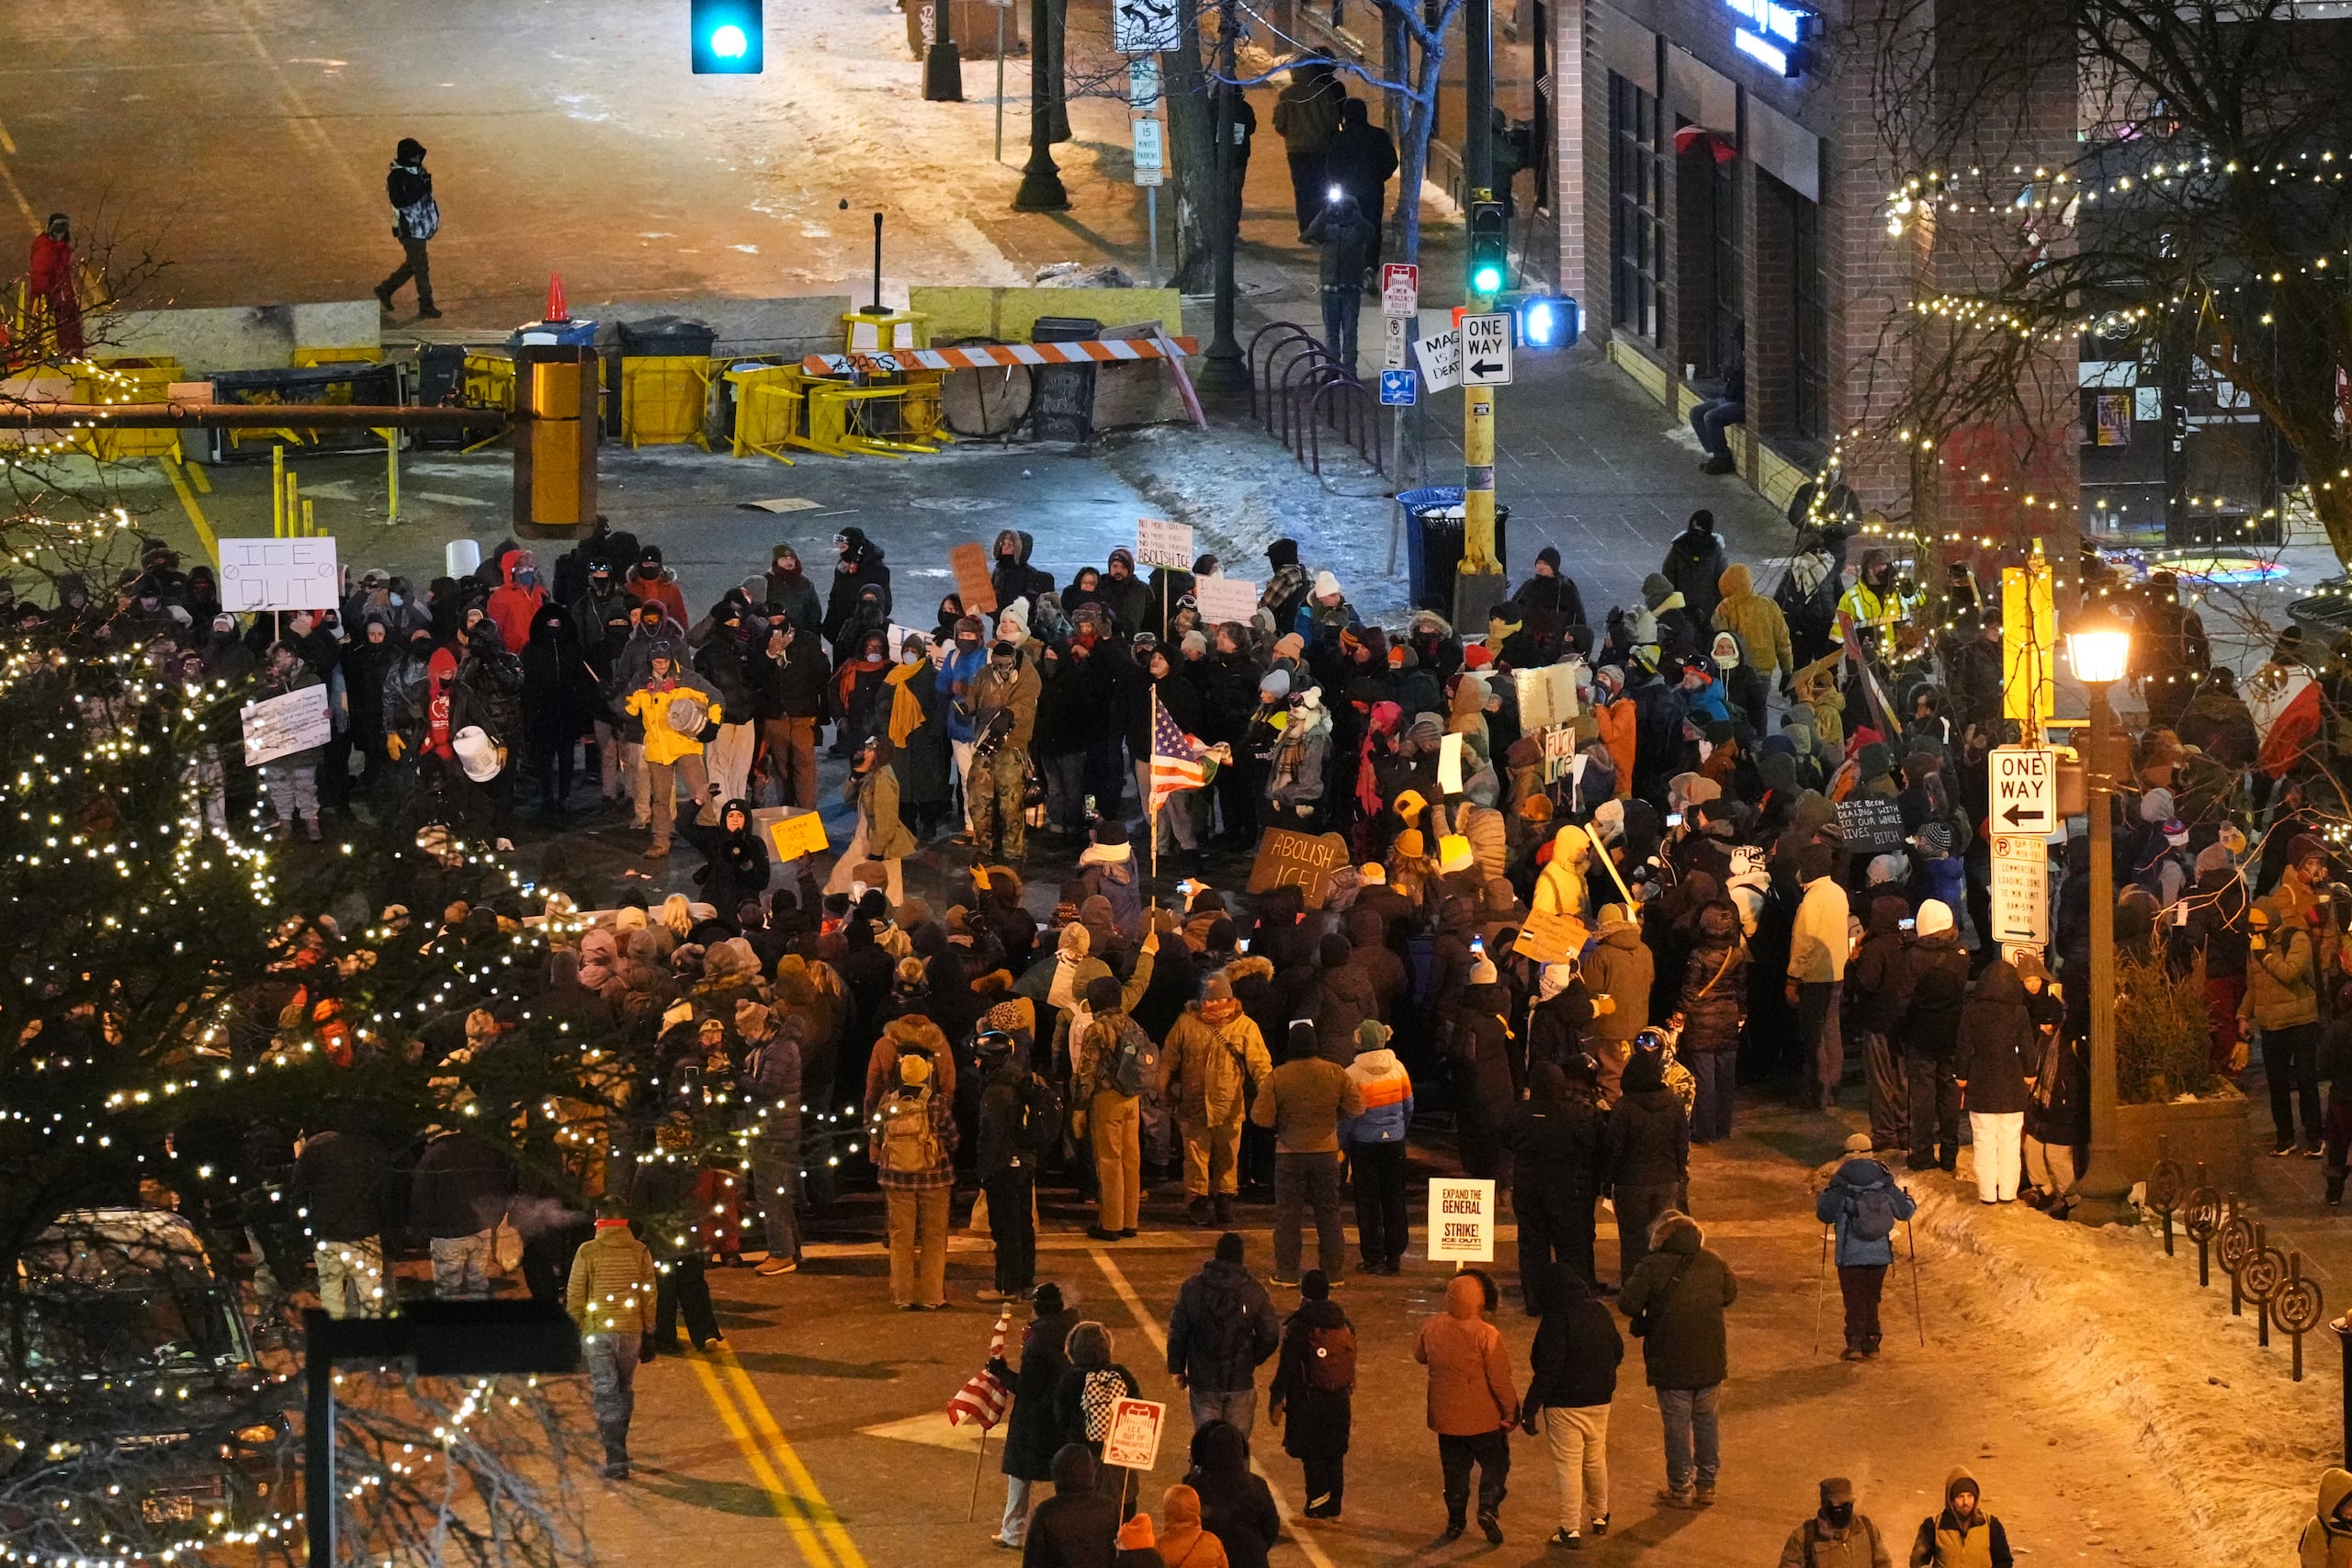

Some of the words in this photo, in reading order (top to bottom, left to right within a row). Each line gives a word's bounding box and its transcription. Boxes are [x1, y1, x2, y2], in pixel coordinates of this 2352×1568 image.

[1143, 128, 1151, 137] 15
[1137, 152, 1159, 160] PARKING
[1469, 320, 1501, 336] ONE
[1426, 331, 1460, 353] MAG
[1468, 339, 1502, 355] WAY
[1435, 353, 1448, 364] IS
[1433, 361, 1460, 379] DEAT
[1139, 519, 1148, 528] NO
[1139, 531, 1149, 539] NO
[239, 544, 315, 566] ICE
[1139, 548, 1175, 566] ABOLISH
[1176, 553, 1192, 569] ICE
[241, 579, 317, 605] OUT
[1548, 730, 1574, 759] FUCK
[2003, 758, 2042, 776] ONE
[2001, 780, 2043, 798] WAY
[1836, 800, 1862, 810] WE'VE
[1865, 799, 1885, 807] BEEN
[1838, 808, 1873, 819] DEALING
[1877, 805, 1899, 815] WITH
[1839, 818, 1854, 828] ICE
[1858, 817, 1875, 826] OUR
[1878, 814, 1902, 824] WHOLE
[1873, 830, 1900, 844] BITCH
[1271, 833, 1335, 869] ABOLISH
[2016, 851, 2041, 859] MON-FRI
[2001, 863, 2037, 874] COMMERCIAL
[1998, 876, 2023, 886] LOADING
[2027, 879, 2041, 887] ZONE
[2012, 889, 2021, 897] MIN
[2025, 891, 2039, 900] LIMIT
[2007, 902, 2034, 911] 8AM-5PM
[2008, 915, 2033, 924] MON-FRI
[1442, 1189, 1468, 1199] EXPAND
[1470, 1190, 1482, 1200] THE
[1442, 1200, 1481, 1214] GENERAL
[1444, 1223, 1478, 1237] STRIKE!
